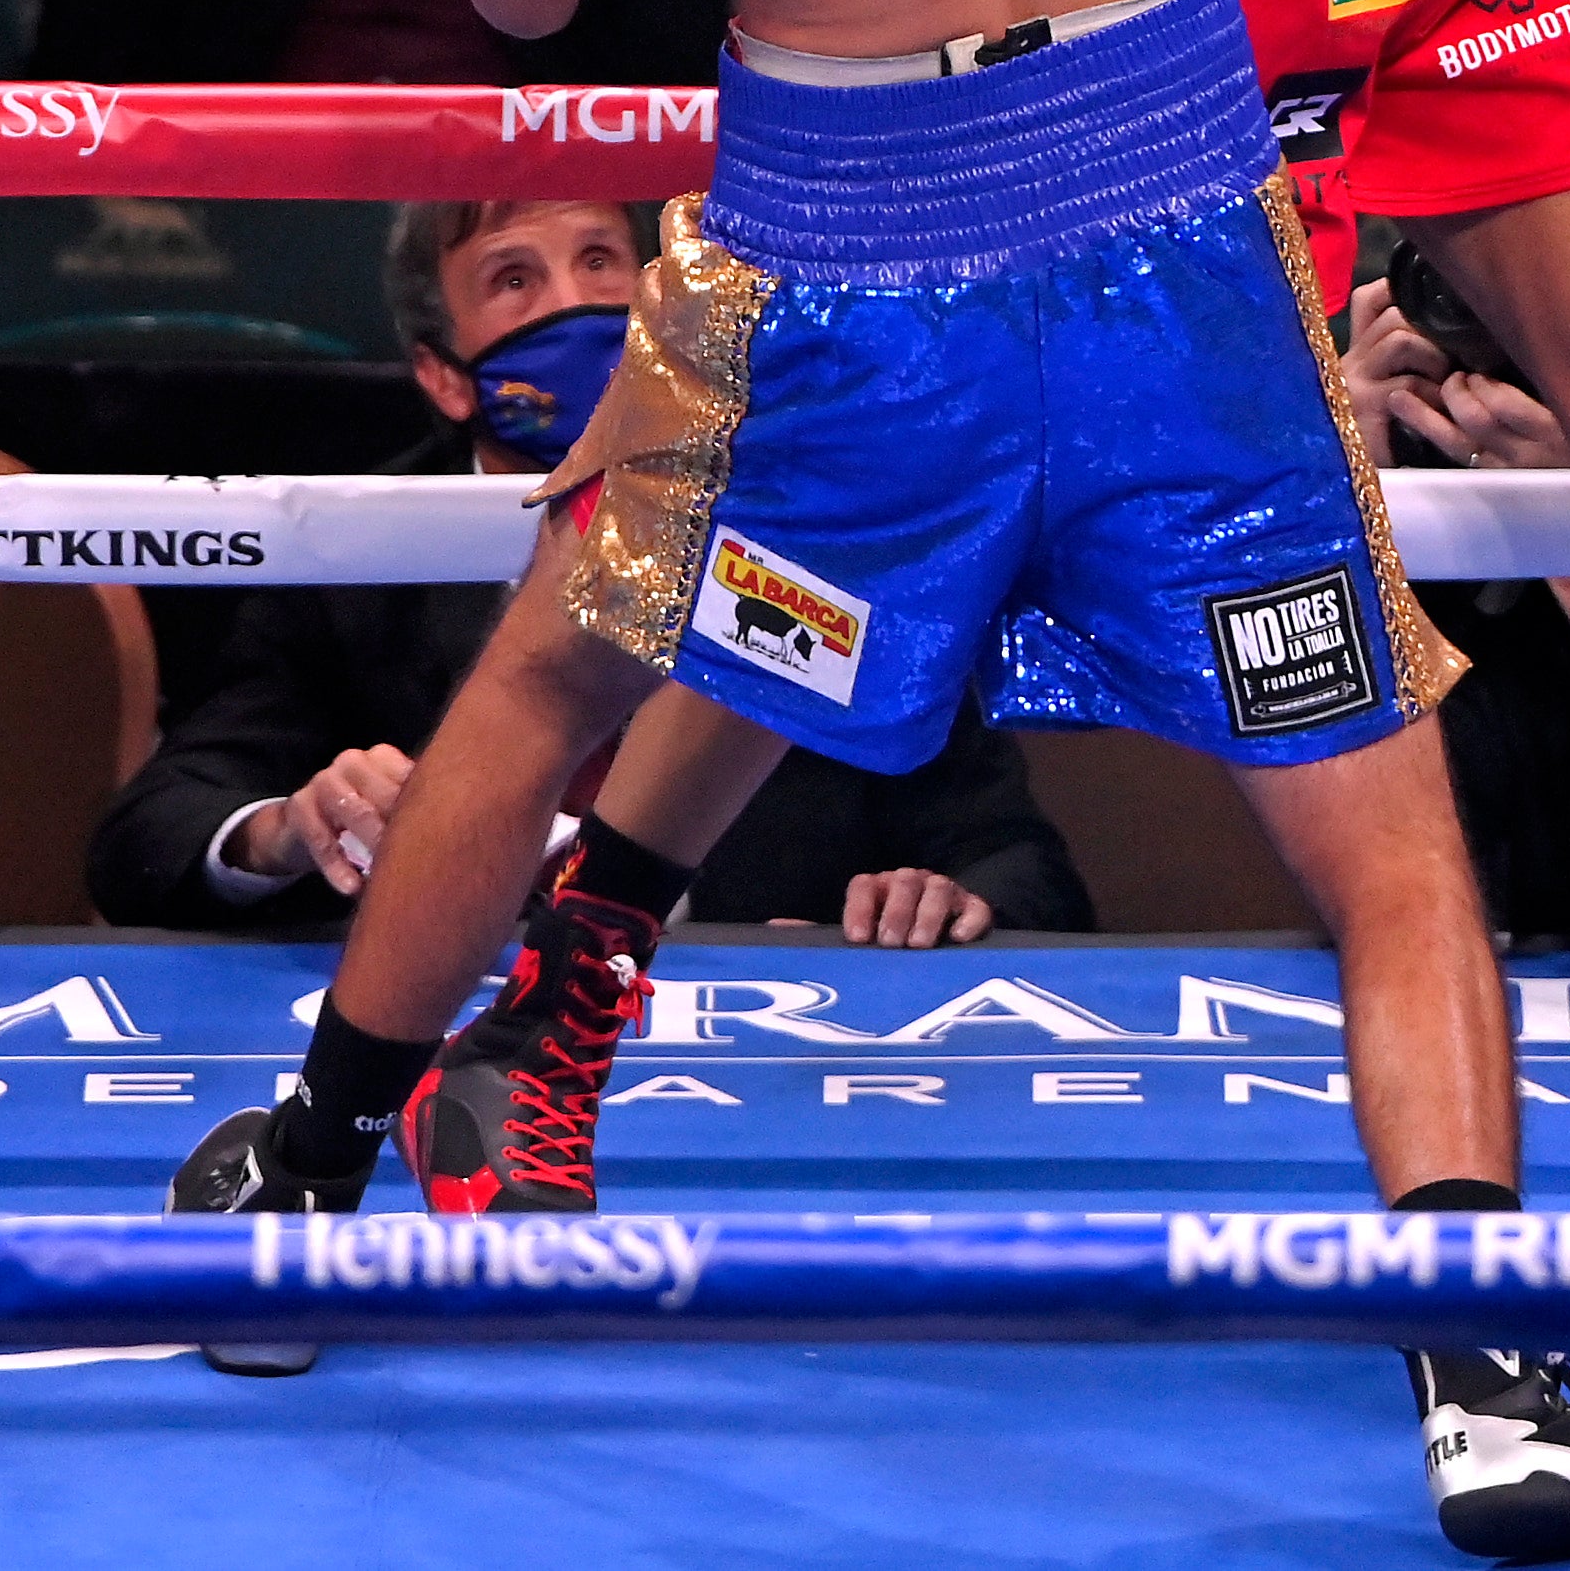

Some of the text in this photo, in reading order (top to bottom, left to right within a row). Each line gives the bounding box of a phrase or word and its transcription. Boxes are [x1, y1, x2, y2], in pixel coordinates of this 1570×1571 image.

[502, 86, 715, 143] MGM
[725, 560, 851, 640] LA BARCA
[1276, 588, 1341, 637] TIRES
[1228, 606, 1287, 671] NO
[1287, 625, 1346, 662] LA TOALLA
[1263, 660, 1336, 693] FUNDACIÓN
[248, 1210, 720, 1311] Hennessy
[1165, 1211, 1429, 1289] MGM
